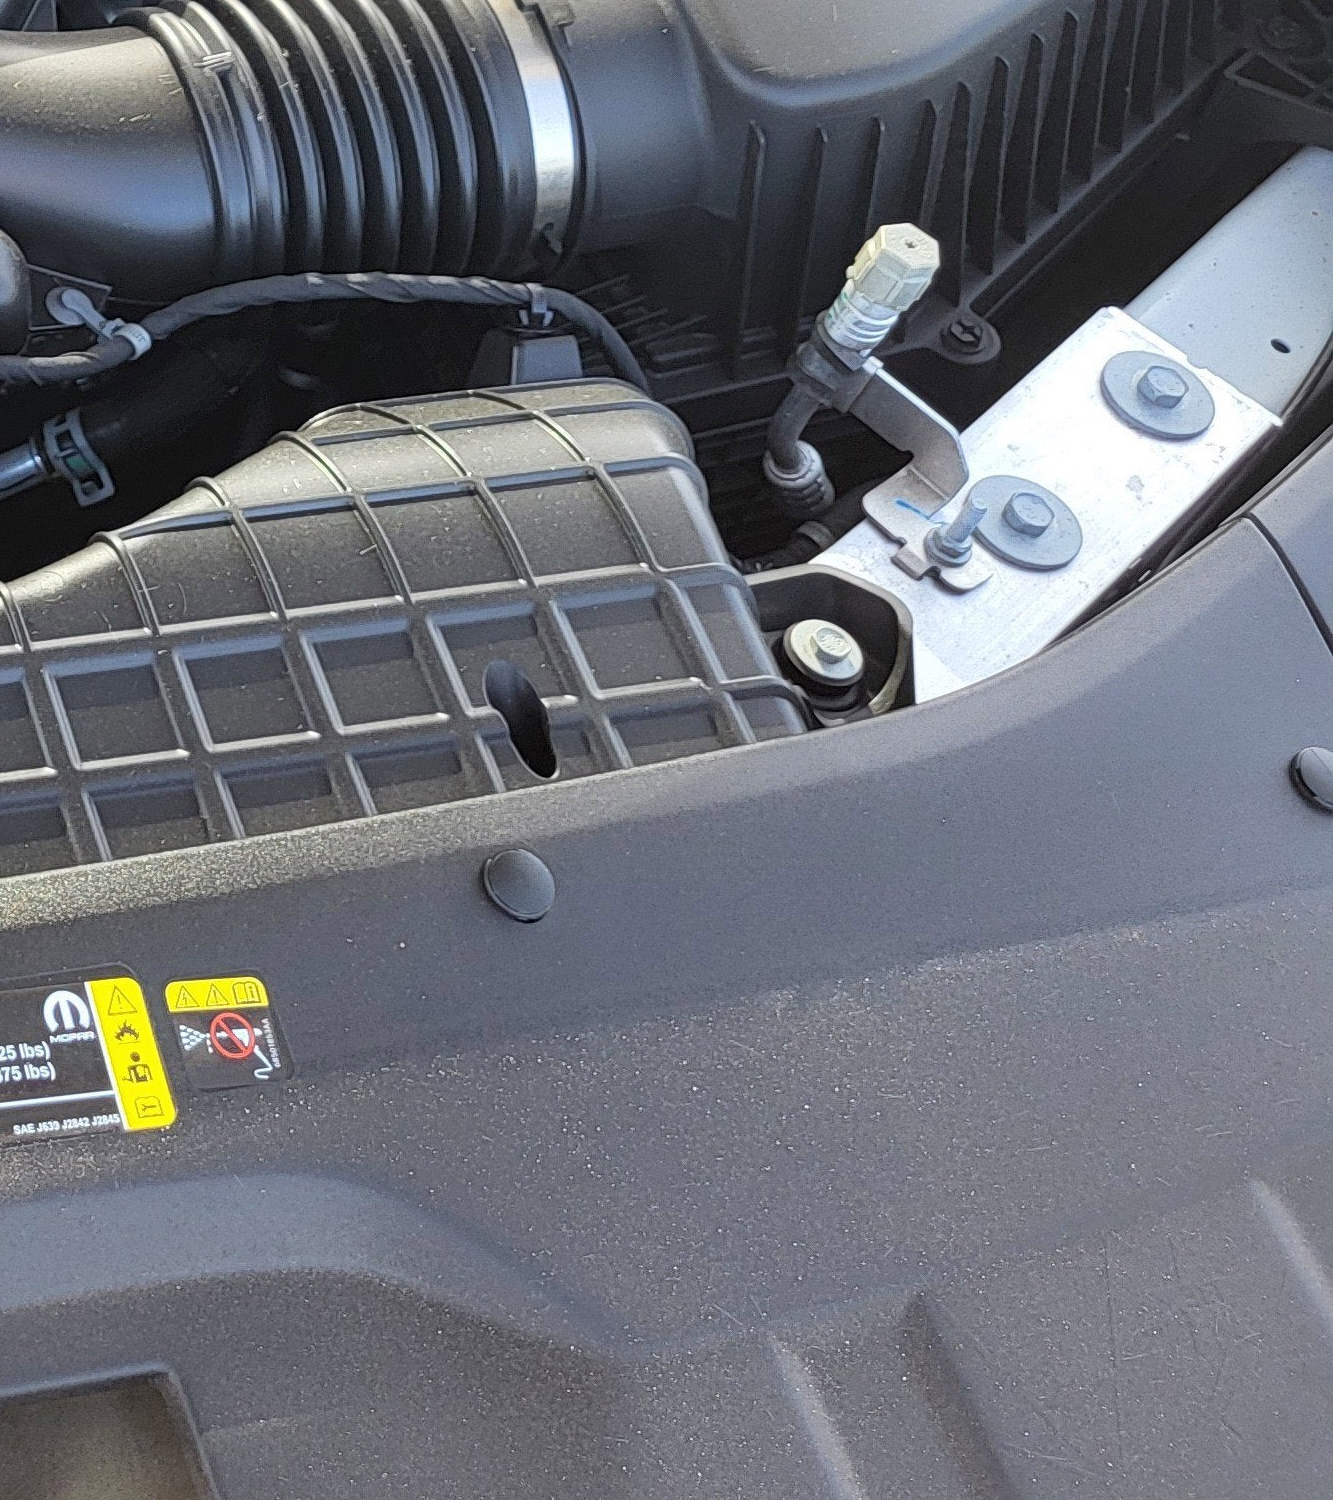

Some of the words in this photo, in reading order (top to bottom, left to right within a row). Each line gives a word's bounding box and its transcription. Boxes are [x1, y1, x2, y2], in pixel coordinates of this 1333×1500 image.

[49, 1031, 96, 1044] MOPAR
[18, 1040, 52, 1061] lbs)
[24, 1061, 57, 1083] lbs)
[13, 1123, 36, 1136] SAE
[36, 1120, 61, 1133] J639
[61, 1117, 91, 1131] J2842
[91, 1113, 121, 1127] J2845
